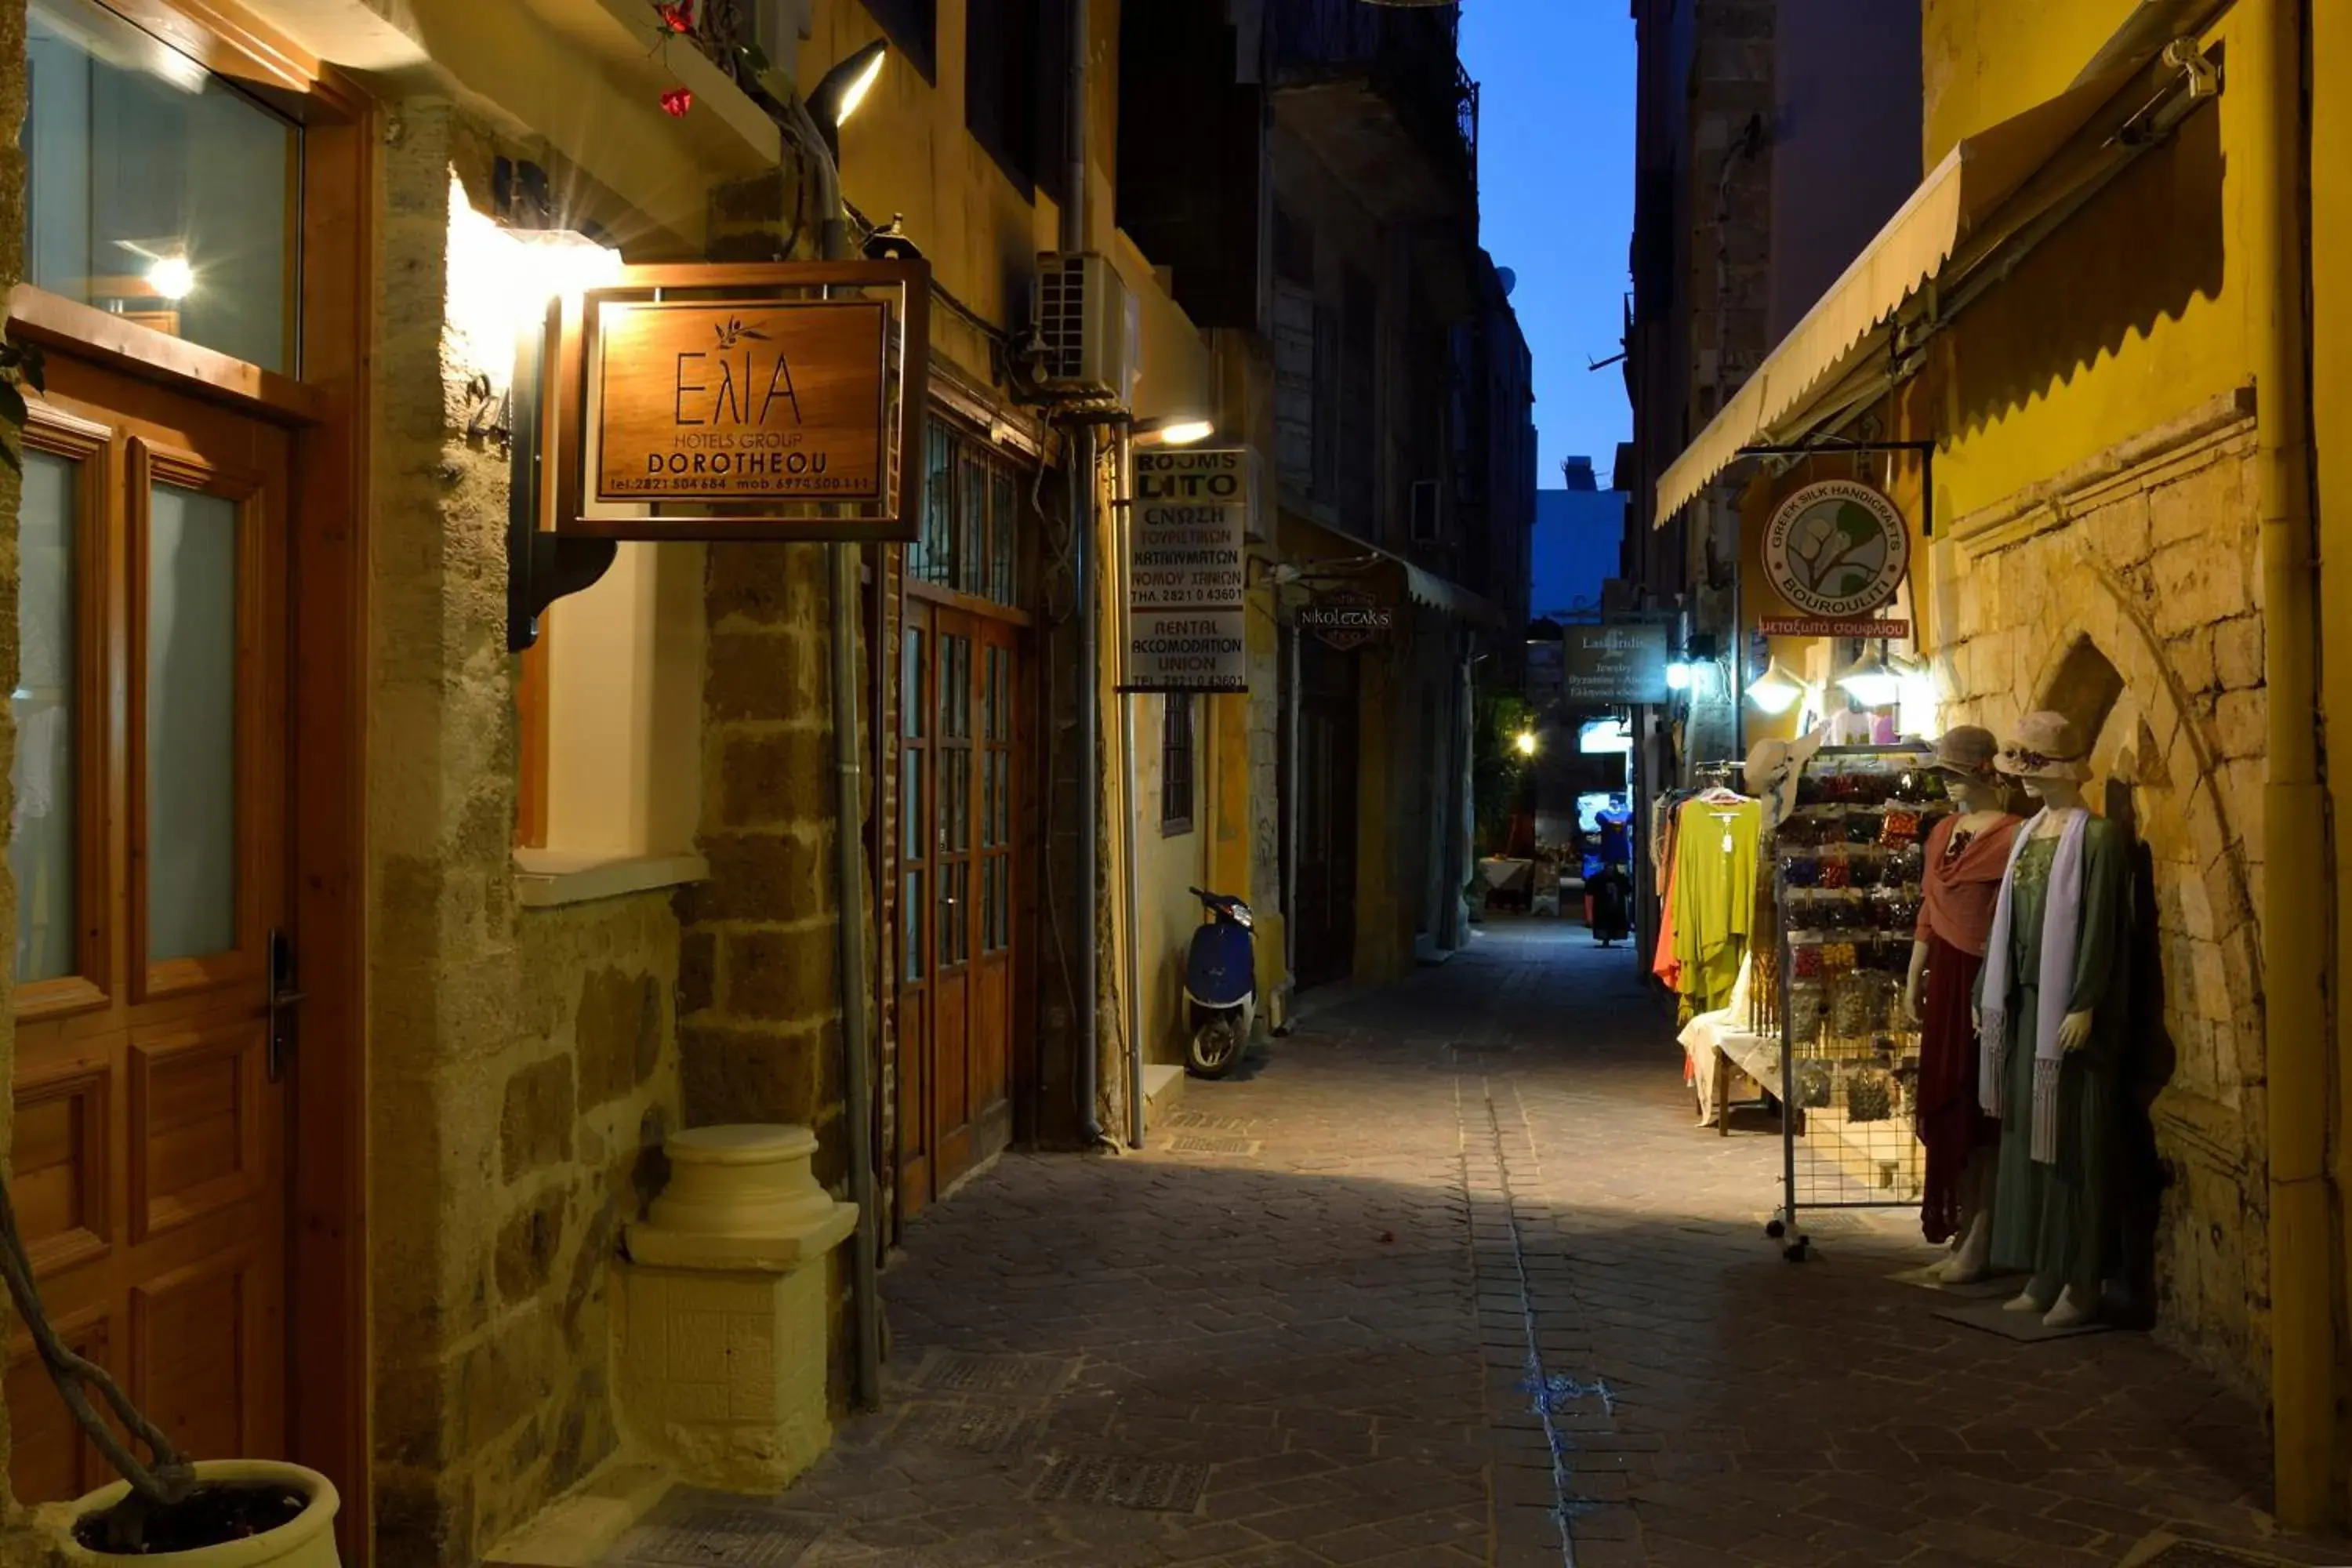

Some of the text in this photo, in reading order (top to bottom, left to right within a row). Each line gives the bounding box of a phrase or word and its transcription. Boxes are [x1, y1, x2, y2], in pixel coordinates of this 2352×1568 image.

[675, 433, 803, 449] HOTELS GROUP
[648, 452, 827, 474] DOROTHEOU
[1138, 453, 1237, 470] ROOMS
[1138, 474, 1237, 497] LITO
[1772, 486, 1901, 551] GREEK SILK HANDICRAFTS
[1783, 577, 1889, 614] BOUROULITI
[1155, 620, 1219, 635] RENTAL
[1158, 657, 1216, 672] UNION
